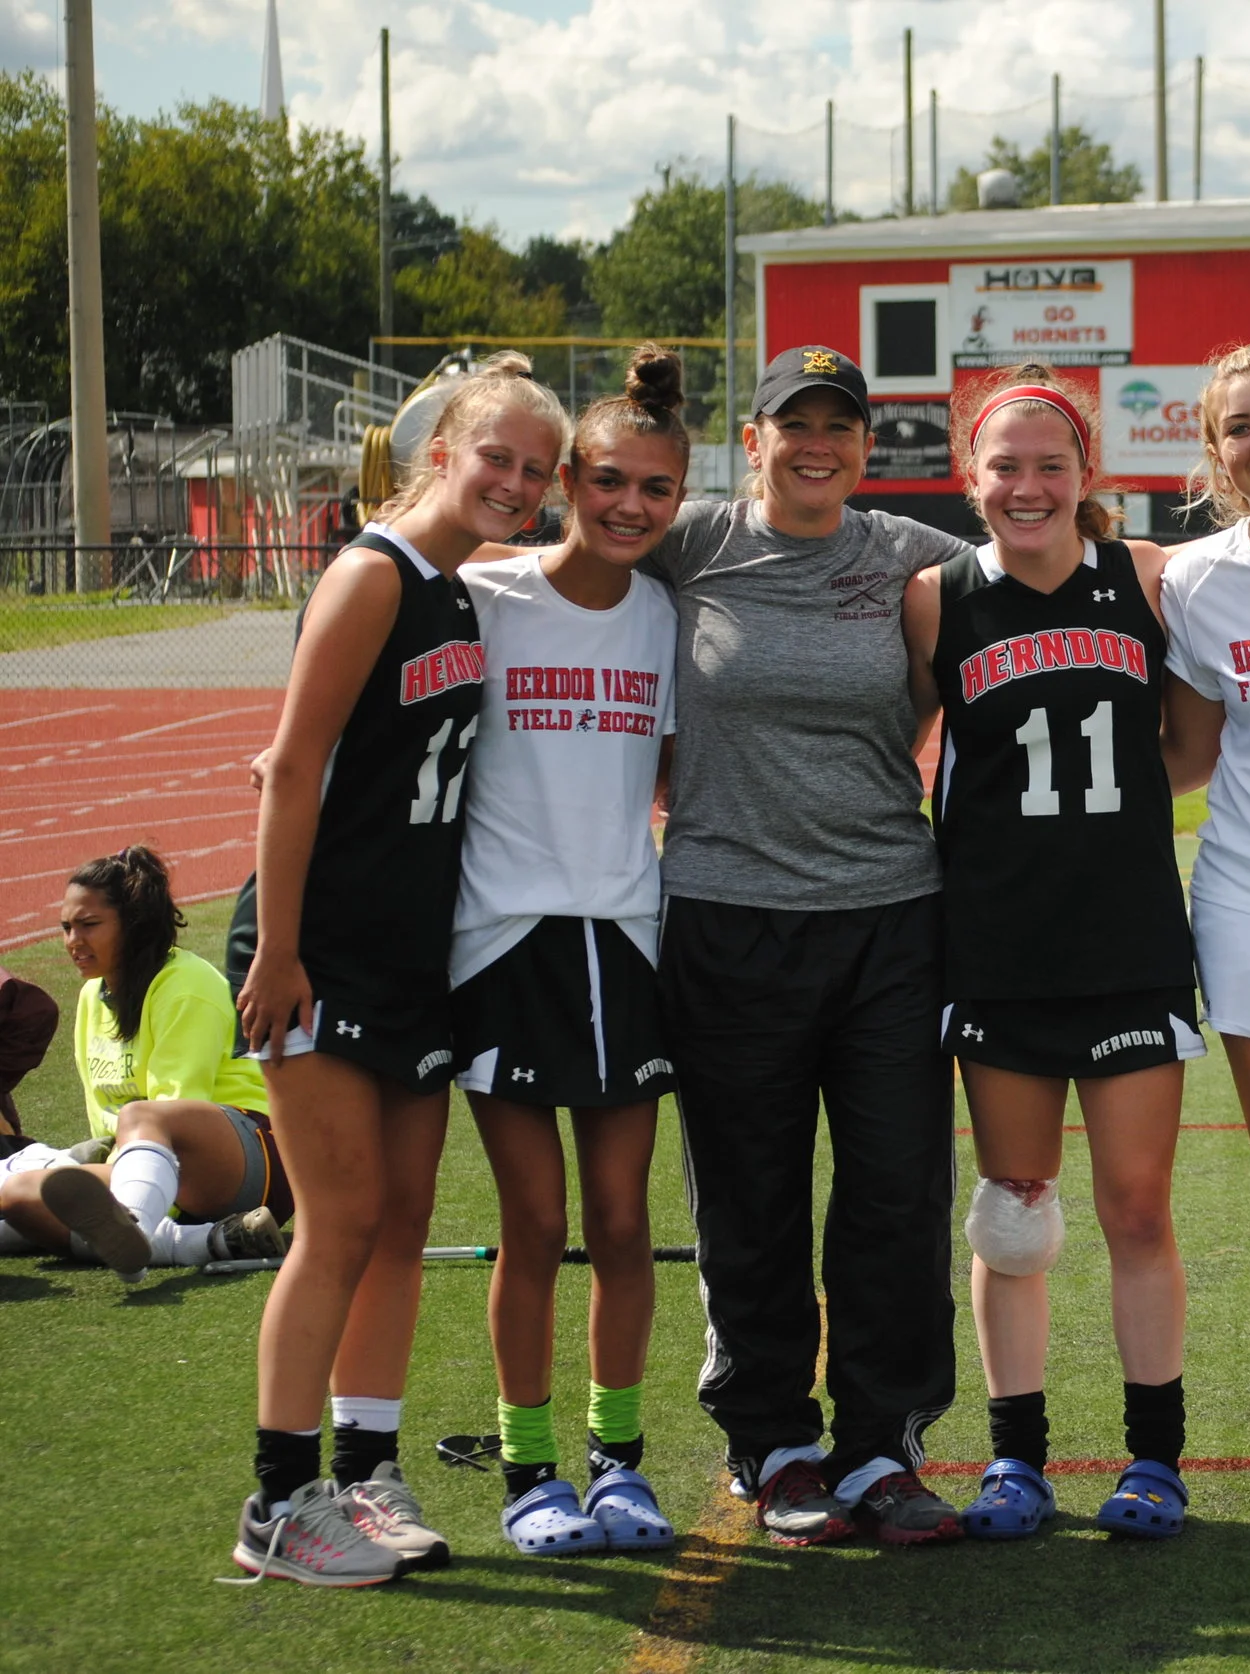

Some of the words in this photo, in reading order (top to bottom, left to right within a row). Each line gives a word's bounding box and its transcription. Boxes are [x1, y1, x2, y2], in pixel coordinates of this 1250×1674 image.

[1044, 305, 1076, 323] GO
[1013, 326, 1107, 344] HORNETS
[1130, 425, 1200, 444] HORN
[830, 575, 863, 590] BROAD
[834, 611, 859, 621] FIELD
[960, 627, 1149, 704] HERNDON
[505, 667, 596, 701] HERNDON
[507, 709, 573, 731] FIELD
[597, 710, 656, 737] HOCKEY
[1016, 700, 1122, 816] 11
[1091, 1029, 1165, 1062] HERNDON
